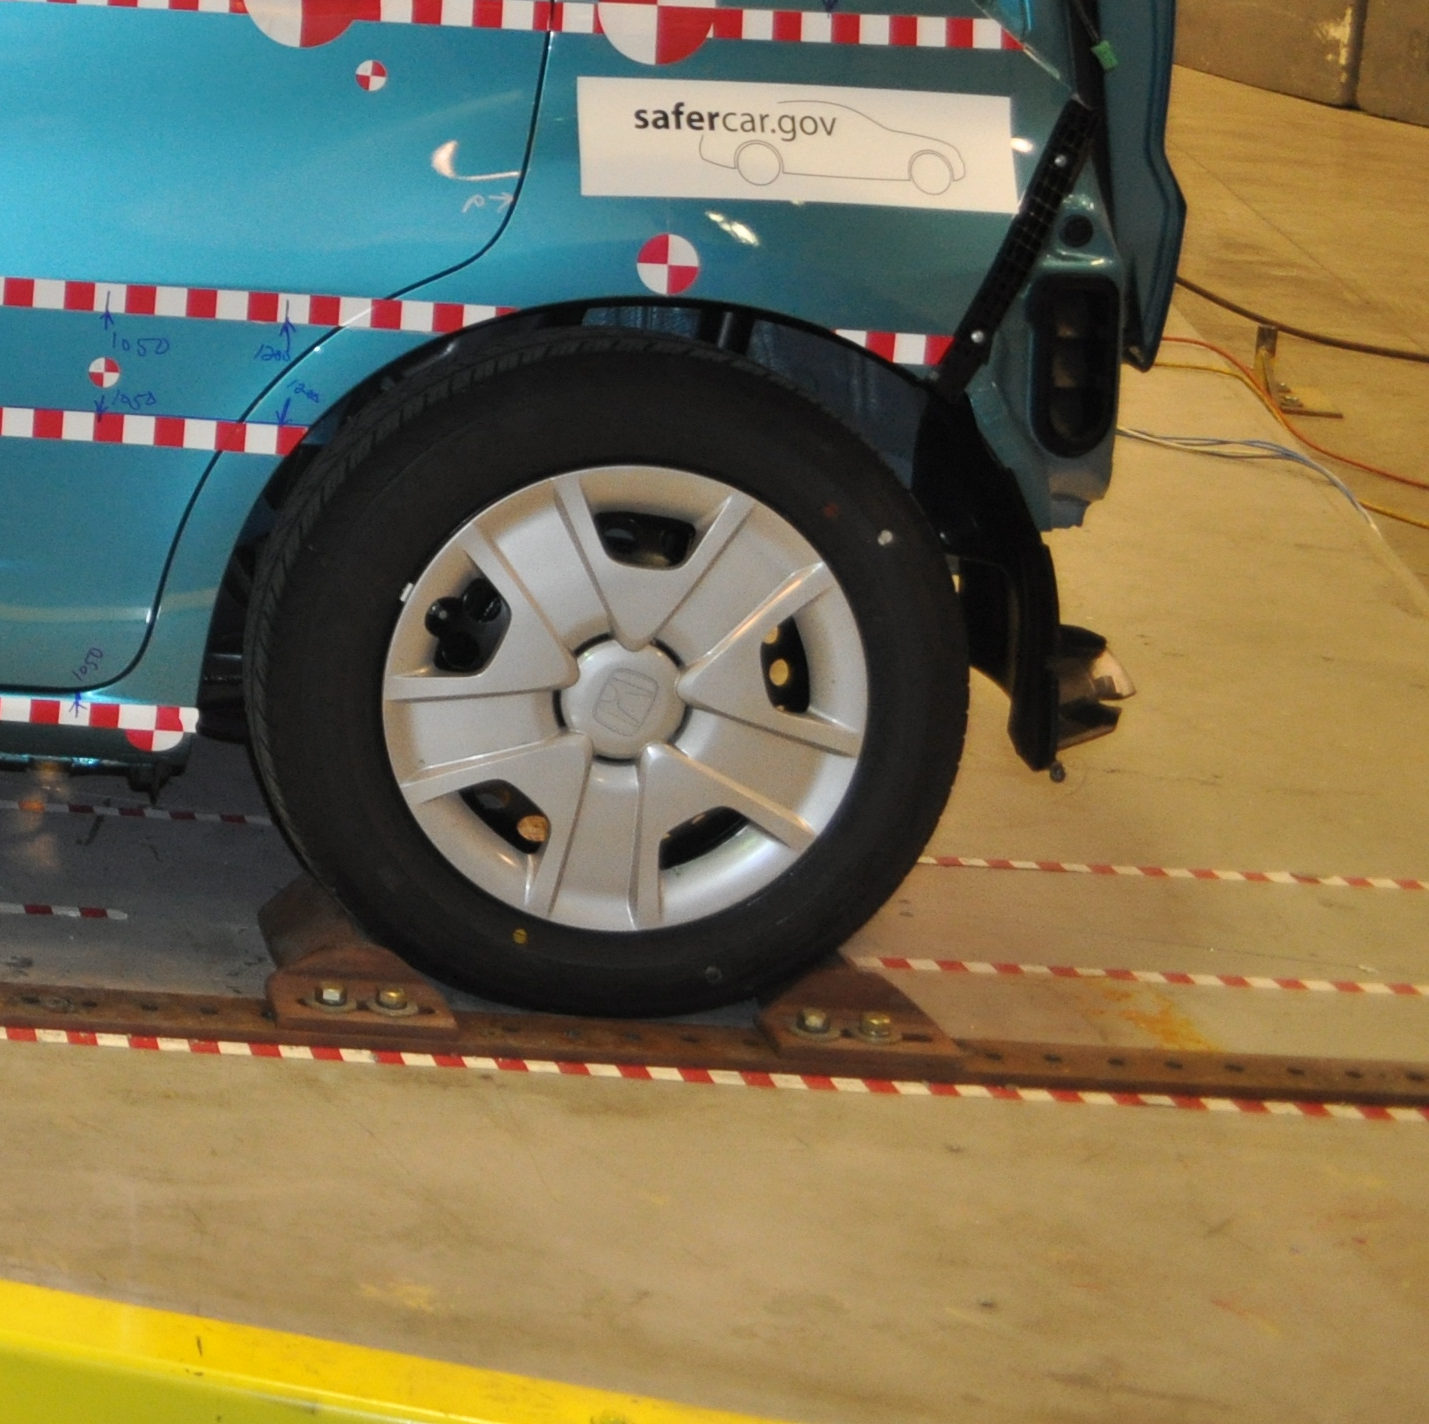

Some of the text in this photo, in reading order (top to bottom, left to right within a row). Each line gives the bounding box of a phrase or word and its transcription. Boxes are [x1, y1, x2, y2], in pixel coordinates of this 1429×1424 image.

[634, 101, 837, 142] safercar.gov
[111, 331, 170, 355] 1050
[72, 648, 103, 682] 1050
